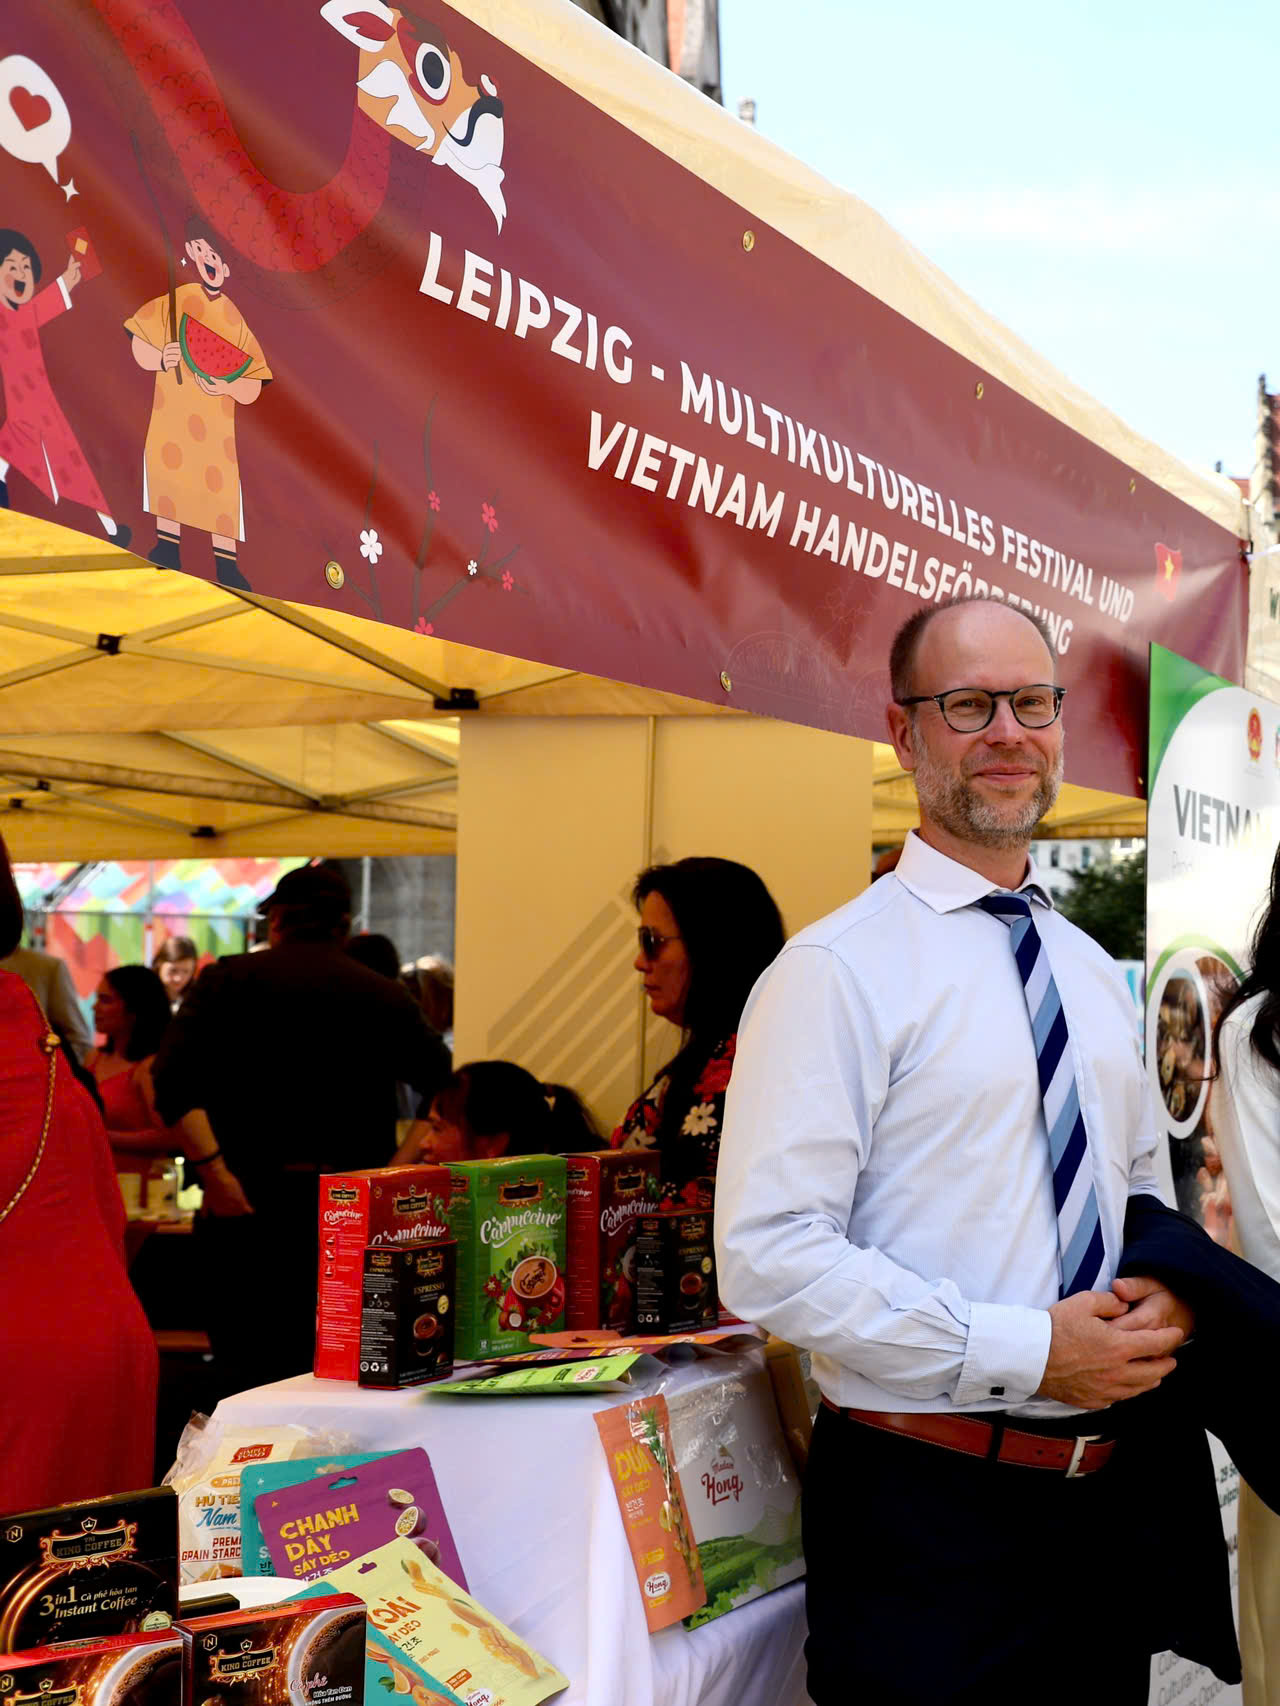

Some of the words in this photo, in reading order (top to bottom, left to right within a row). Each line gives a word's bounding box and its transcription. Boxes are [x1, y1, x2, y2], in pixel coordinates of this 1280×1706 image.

[419, 231, 633, 385] LEIPZIG
[680, 360, 996, 557] MULTIKULTURELLES
[1001, 524, 1094, 606] FESTIVAL
[1098, 575, 1135, 624] UND
[588, 410, 786, 538] VIETNAM
[480, 1207, 561, 1248] Cappuccino
[413, 1281, 446, 1295] ESPRESSO
[701, 1472, 743, 1506] Hong
[196, 1507, 237, 1527] Nam
[280, 1503, 359, 1539] CHANH
[84, 1538, 123, 1552] COFFEE
[181, 1550, 209, 1561] GRAIN
[285, 1534, 332, 1562] DÂY
[646, 1579, 668, 1594] Hong
[55, 1602, 97, 1619] Instant
[100, 1596, 138, 1611] Coffee
[242, 1656, 272, 1668] COFFEE
